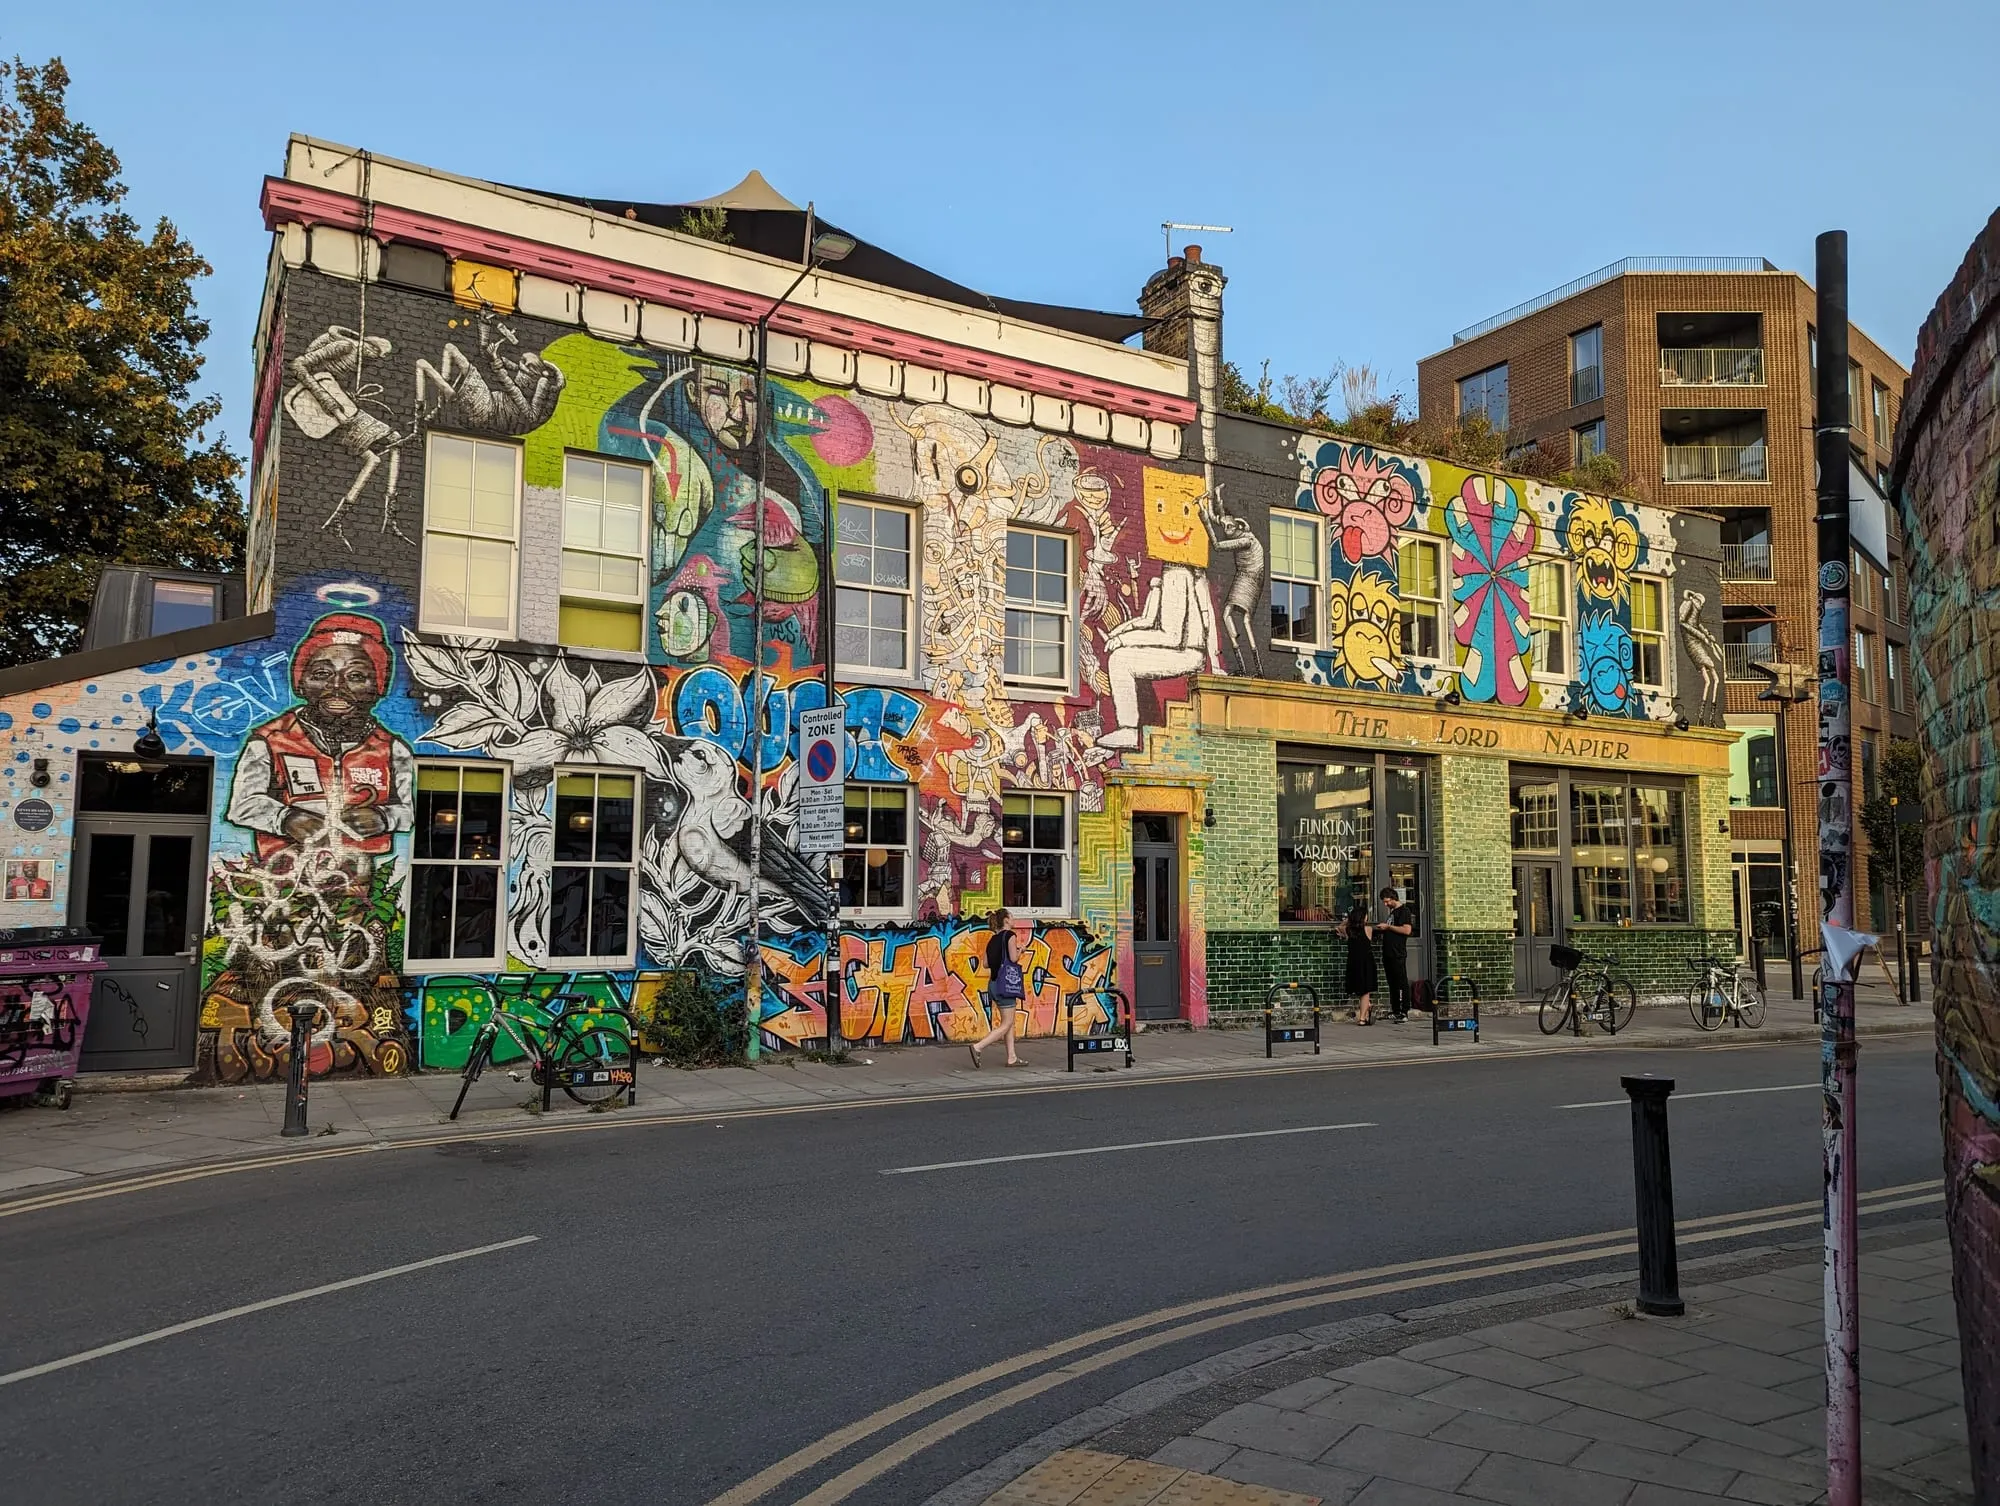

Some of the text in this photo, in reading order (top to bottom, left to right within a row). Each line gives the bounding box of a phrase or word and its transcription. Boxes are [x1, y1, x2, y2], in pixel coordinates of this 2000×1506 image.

[802, 710, 842, 724] Controlled
[807, 723, 836, 738] ZONE
[1334, 709, 1630, 760] THE LORD NAPIER
[1300, 818, 1355, 836] FUNKTION
[1294, 844, 1358, 861] KARAOKE
[1312, 861, 1340, 873] ROOM
